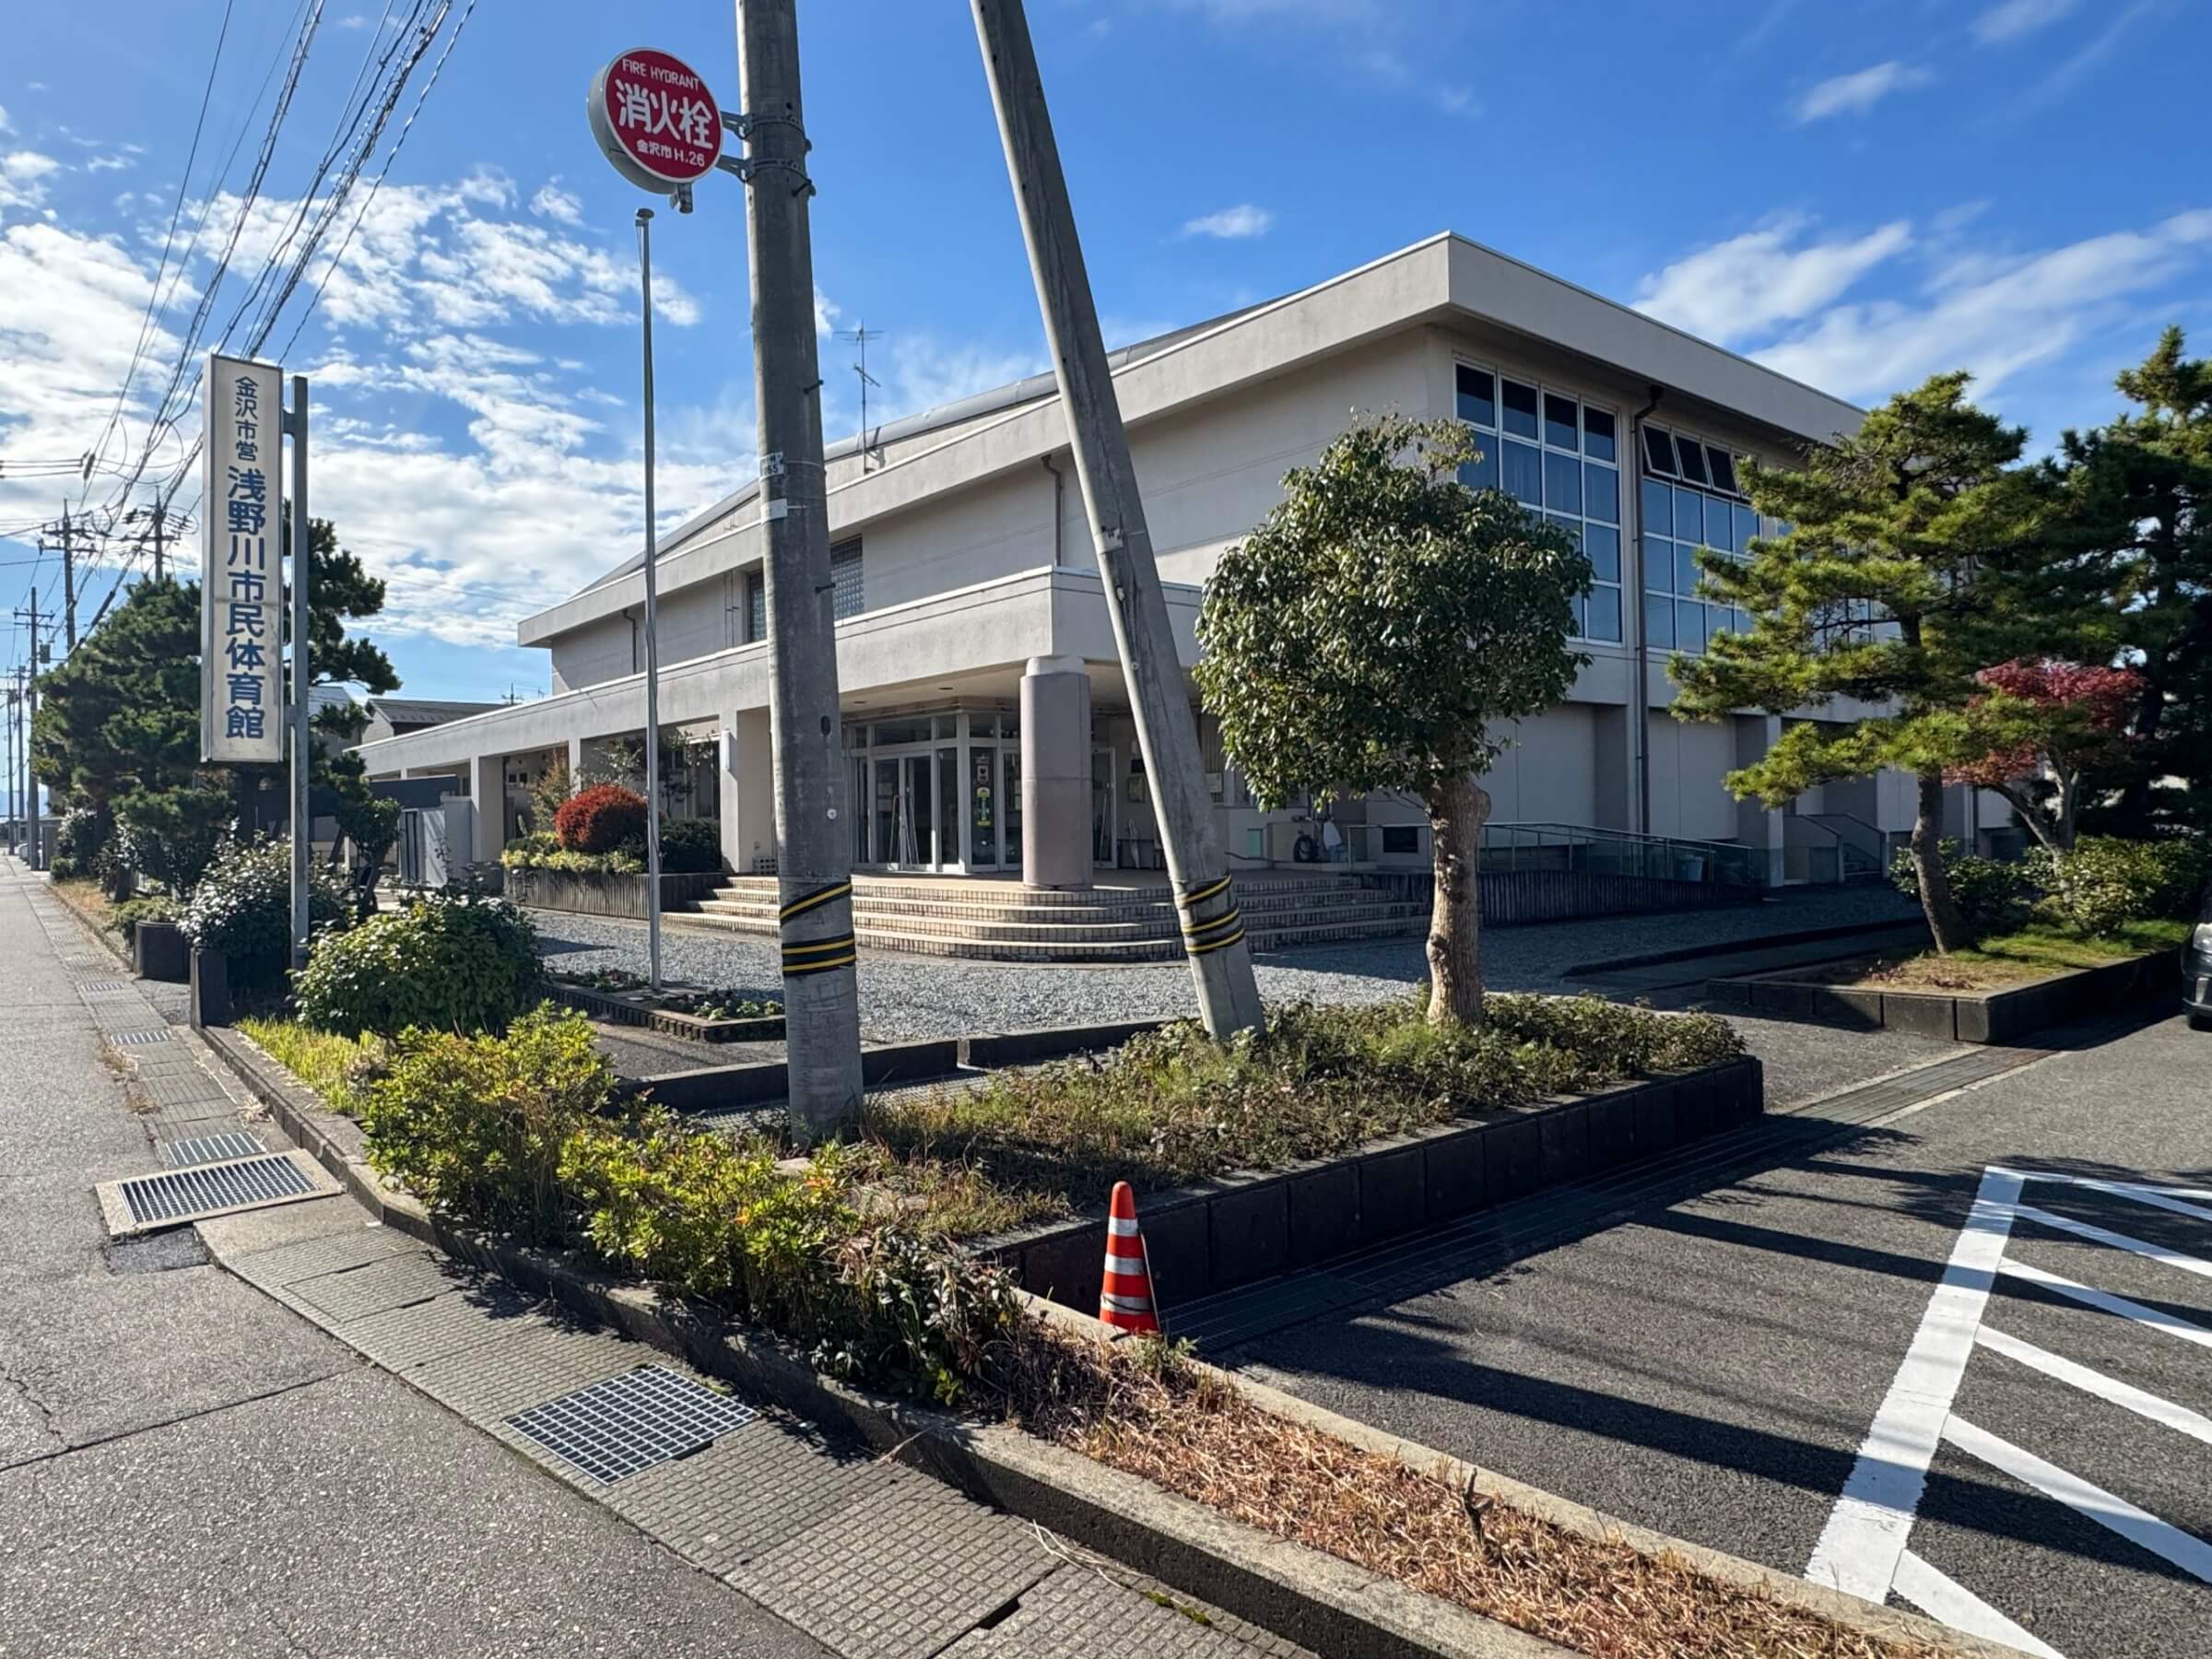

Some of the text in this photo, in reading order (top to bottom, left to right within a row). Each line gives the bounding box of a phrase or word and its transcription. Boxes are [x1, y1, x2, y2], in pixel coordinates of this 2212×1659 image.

[622, 58, 700, 91] FIRE HYDRANT
[615, 78, 713, 149] 消火栓
[636, 139, 705, 167] 金沢市 H.26
[225, 376, 266, 738] 金沢市営 浅野川市民体育館
